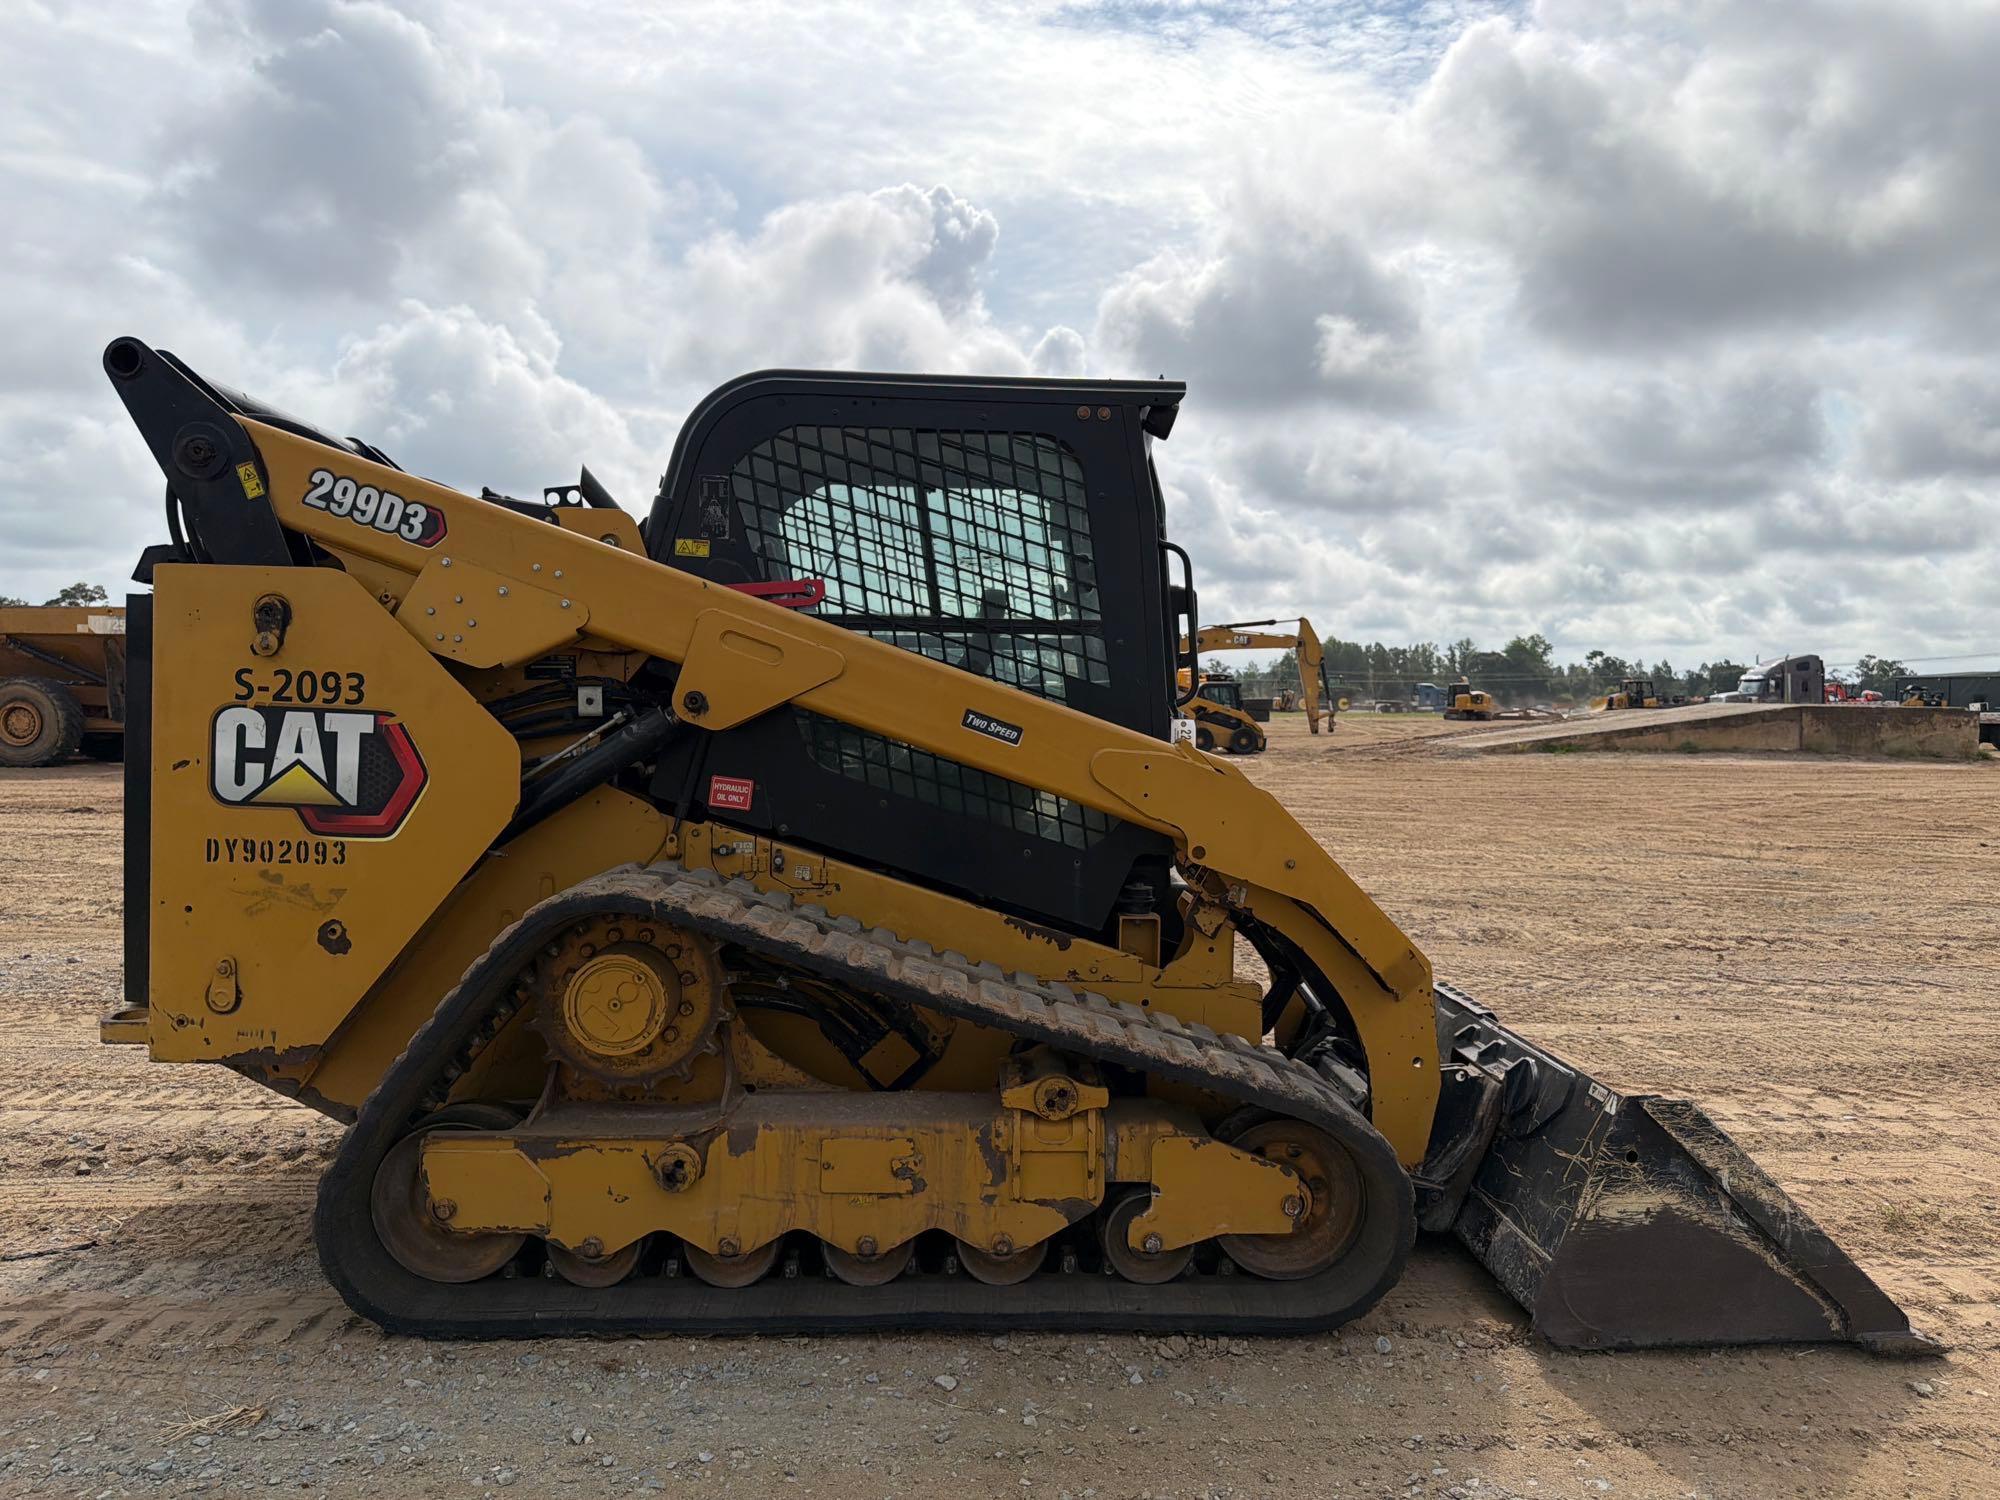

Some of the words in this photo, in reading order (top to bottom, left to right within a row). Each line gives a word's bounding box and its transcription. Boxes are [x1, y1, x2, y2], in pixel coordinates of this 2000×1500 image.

[304, 470, 428, 540] 299D3
[1233, 635, 1249, 645] CAT
[235, 668, 365, 705] S-2093
[215, 707, 375, 806] CAT
[714, 783, 749, 794] HYDRAULIC
[716, 793, 727, 801] OIL
[728, 794, 745, 803] ONLY
[206, 838, 346, 865] DY902093
